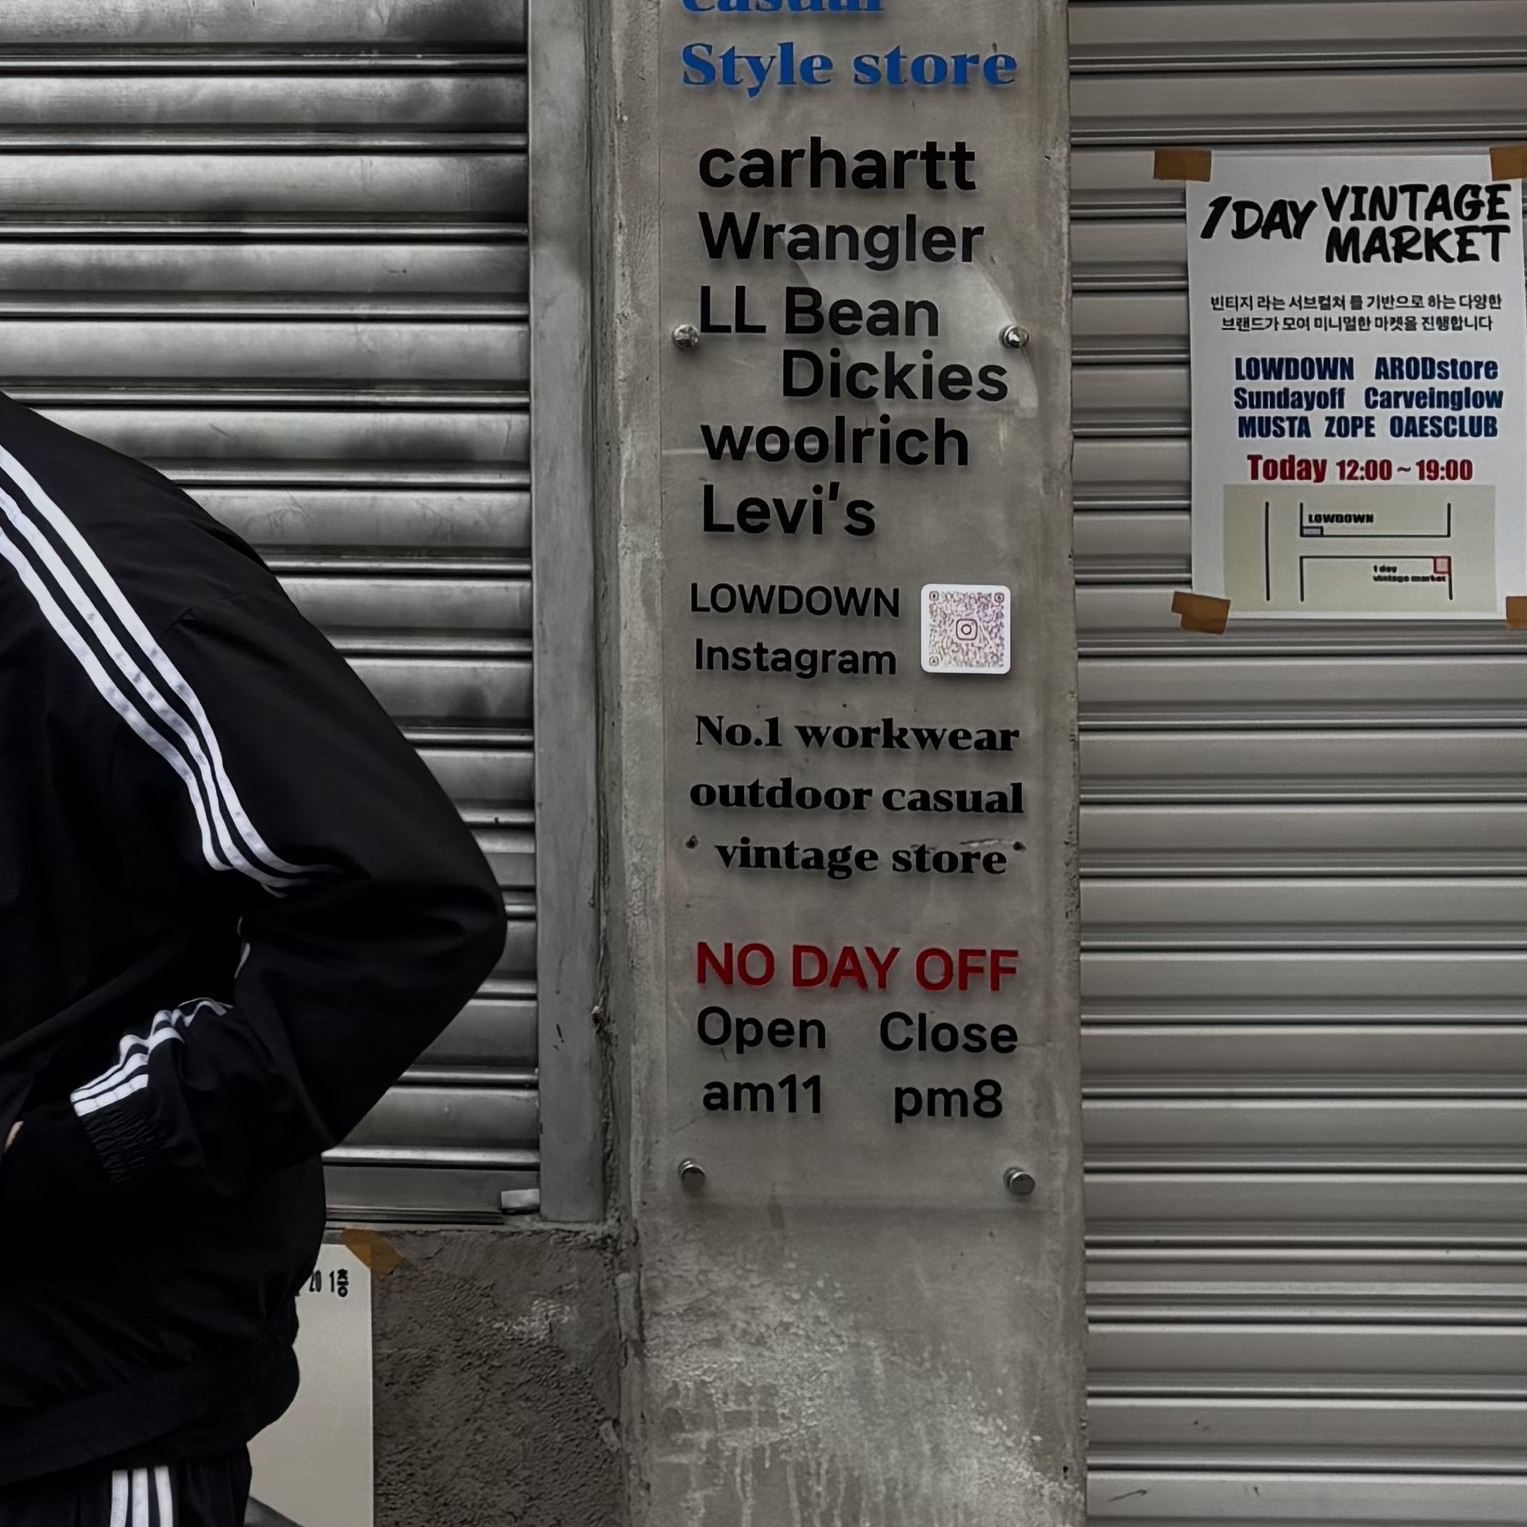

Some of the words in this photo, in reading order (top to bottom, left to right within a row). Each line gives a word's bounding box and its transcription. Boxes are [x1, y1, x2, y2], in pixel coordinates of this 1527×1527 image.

[681, 42, 833, 98] Style
[852, 45, 1017, 86] store
[699, 137, 976, 190] carhartt
[1322, 184, 1511, 222] VINTAGE
[698, 212, 984, 271] Wrangler
[1326, 225, 1510, 263] MARKET
[700, 286, 766, 334] LL
[785, 286, 938, 336] Bean
[1210, 295, 1253, 311] 빈티지
[1257, 295, 1286, 310] 라는
[1367, 295, 1424, 310] 기반으로
[1428, 295, 1456, 310] 하는
[1459, 294, 1502, 310] 다양한
[1222, 316, 1279, 332] 브랜드가
[1282, 316, 1310, 332] 모여
[1421, 316, 1492, 331] 진행합니다
[783, 347, 1008, 401] Dickies
[1235, 357, 1354, 380] LOWDOWN
[1375, 357, 1498, 380] ARODstore
[1234, 387, 1345, 411] Sundayoff
[1364, 387, 1503, 411] Carveinglow
[701, 414, 968, 465] woolrich
[1238, 416, 1311, 438] MUSTA
[1325, 416, 1375, 438] ZOPE
[1390, 416, 1498, 438] OAESCLUB
[1247, 455, 1327, 483] Today
[1336, 459, 1392, 480] 12:00
[1415, 459, 1473, 481] 19:00
[703, 482, 876, 536] Levi's
[1308, 513, 1375, 524] LOWDOWN
[691, 583, 900, 617] LOWDOWN
[695, 639, 897, 679] Instagram
[695, 716, 782, 747] No.1
[795, 718, 1019, 751] workwear
[690, 778, 872, 811] outdoor
[883, 783, 1024, 813] casual
[715, 837, 879, 880] vintage
[893, 844, 1007, 874] store
[697, 942, 774, 985] NO
[792, 945, 900, 989] DAY
[916, 948, 1019, 991] OFF
[697, 1007, 826, 1054] Open
[880, 1012, 1018, 1053] Close
[703, 1074, 821, 1113] am11
[895, 1079, 1003, 1123] pm8
